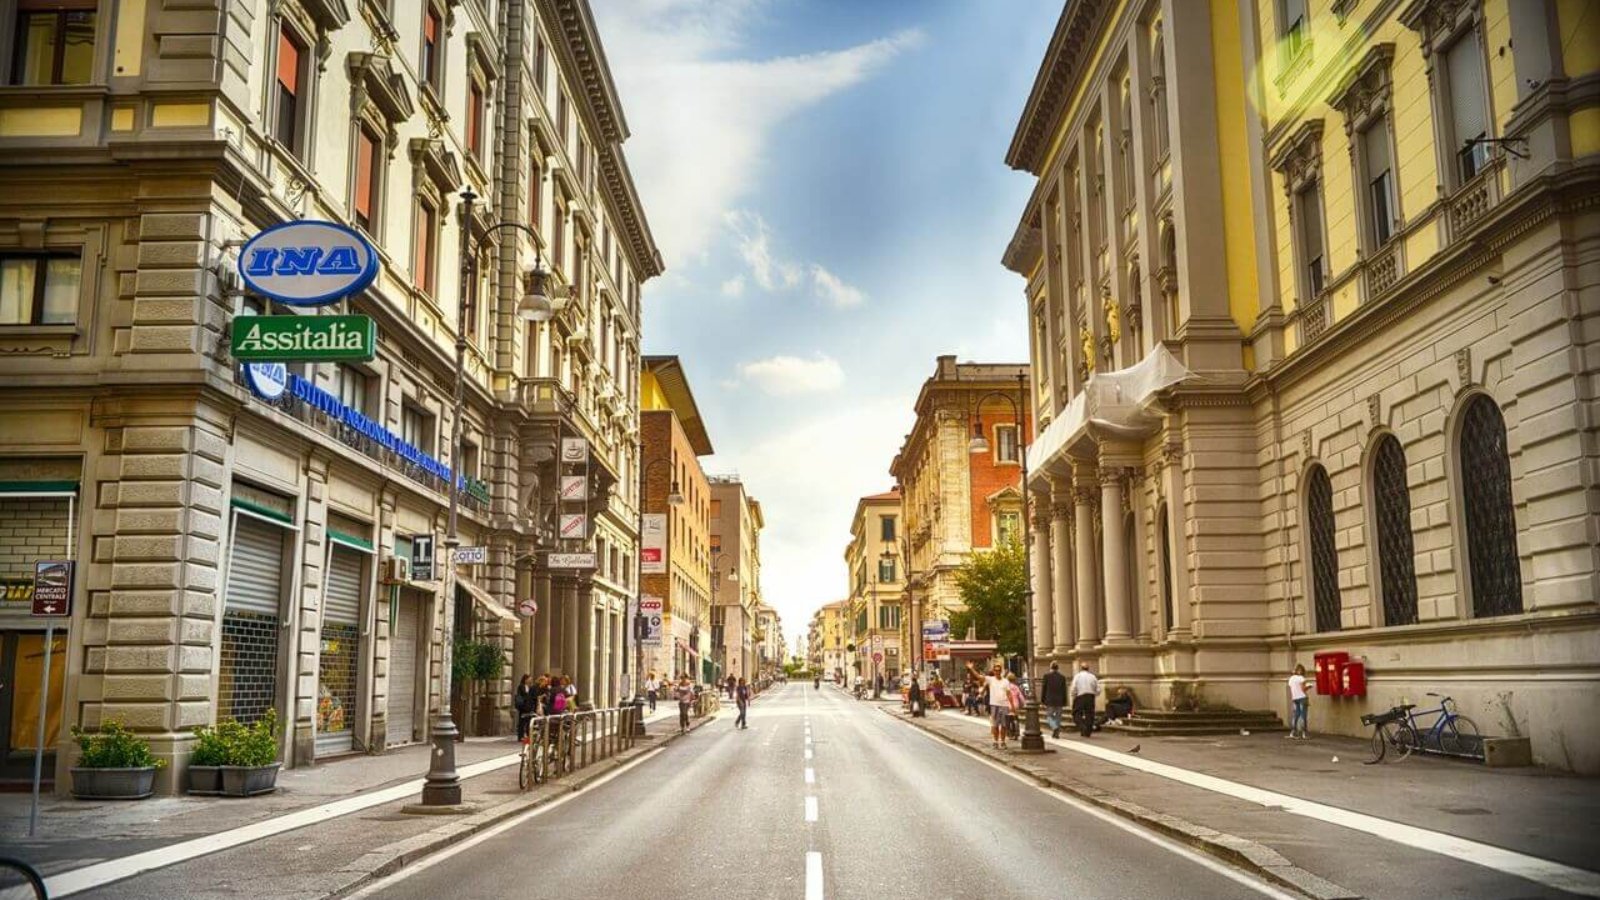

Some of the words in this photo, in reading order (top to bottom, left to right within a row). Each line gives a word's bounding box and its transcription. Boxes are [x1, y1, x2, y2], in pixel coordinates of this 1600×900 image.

[248, 246, 361, 275] INA
[236, 322, 363, 350] Assitalia
[640, 601, 661, 610] coop
